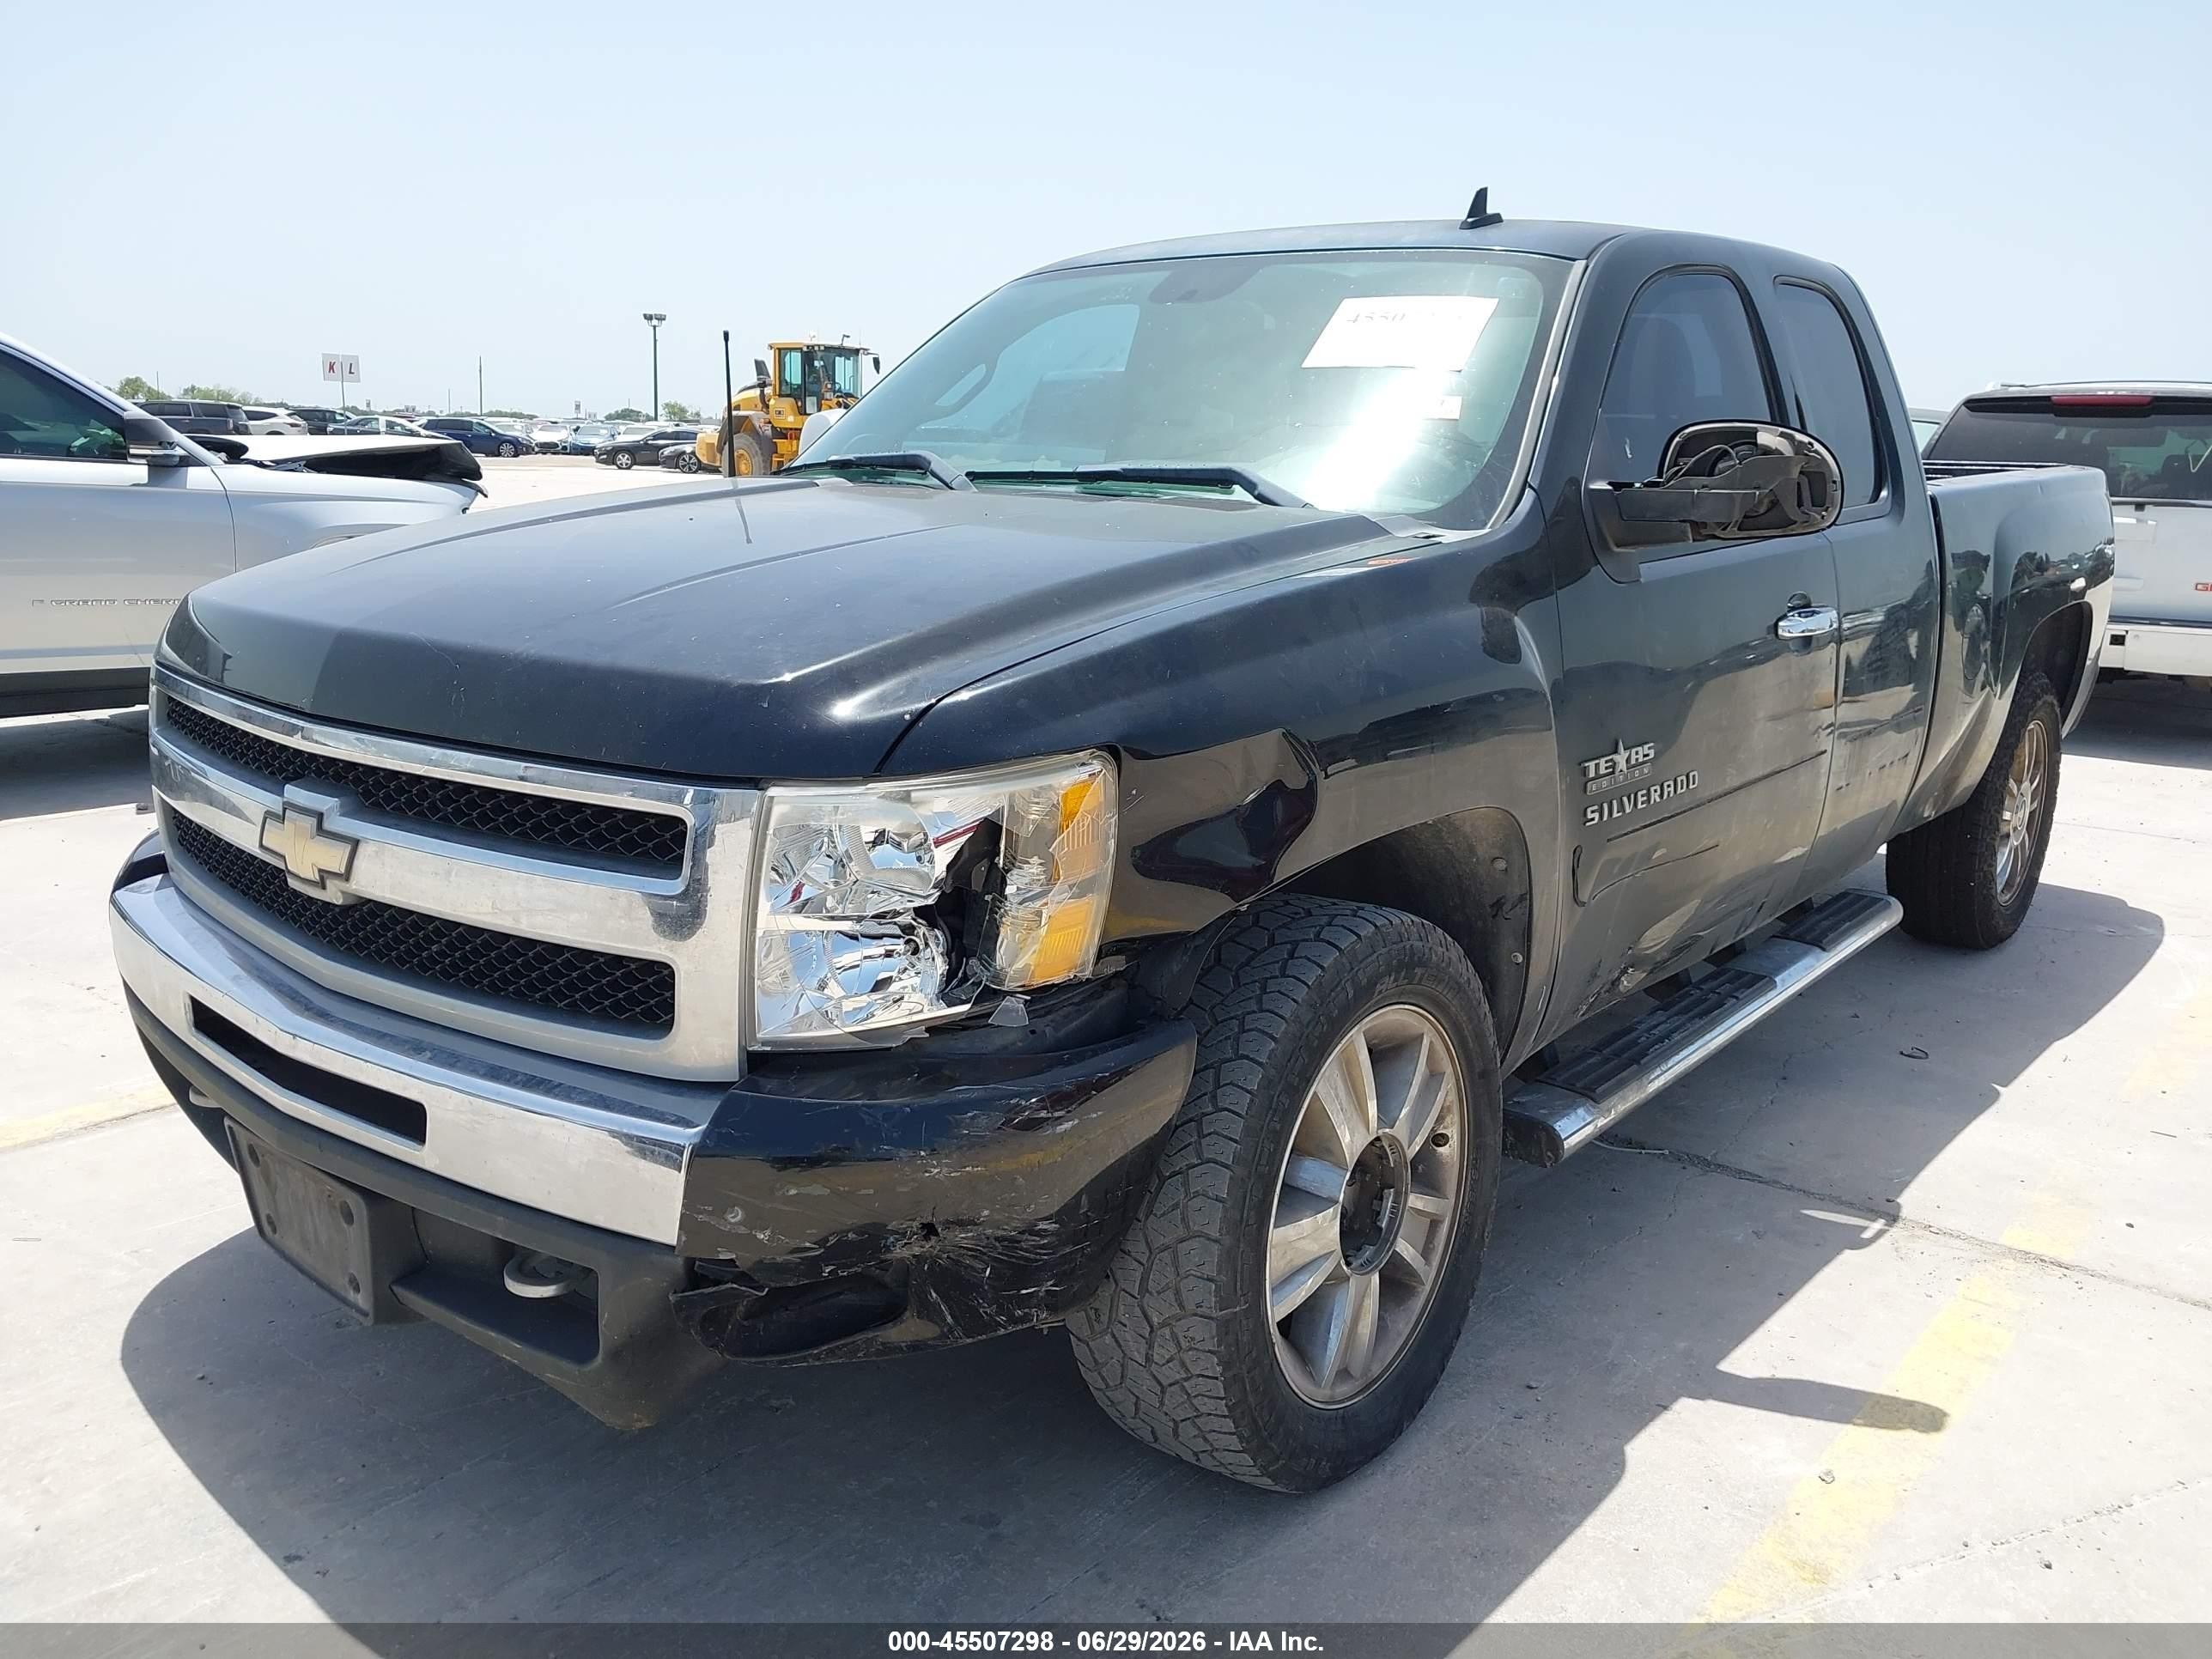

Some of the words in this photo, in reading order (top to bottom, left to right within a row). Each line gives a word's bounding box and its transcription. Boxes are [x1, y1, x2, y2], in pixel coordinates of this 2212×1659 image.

[328, 361, 337, 374] K
[348, 362, 356, 374] L
[1581, 738, 1655, 778] TEXAS
[1590, 768, 1650, 792] EDITION
[1584, 770, 1698, 827] SILVERADO
